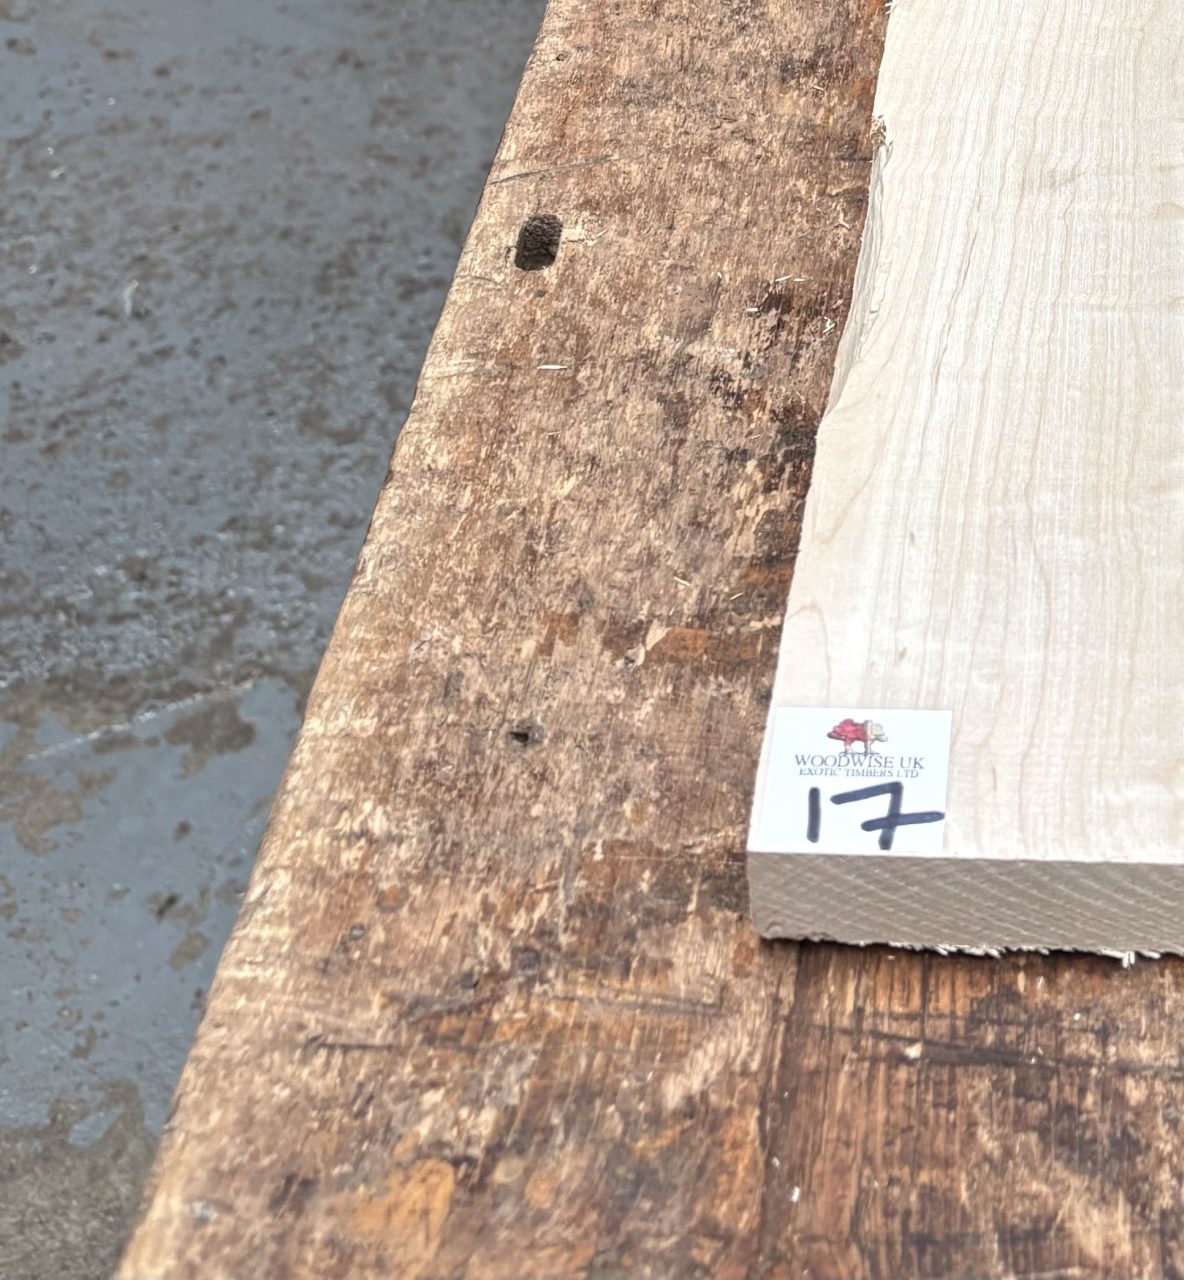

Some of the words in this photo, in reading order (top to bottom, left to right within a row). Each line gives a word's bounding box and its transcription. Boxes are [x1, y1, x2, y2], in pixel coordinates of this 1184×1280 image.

[795, 754, 894, 768] WOODWISE
[900, 756, 924, 769] UK
[799, 767, 841, 776] EXOTIC
[845, 768, 894, 777] TIMBERS
[896, 769, 919, 778] LTD
[807, 781, 945, 850] 17
